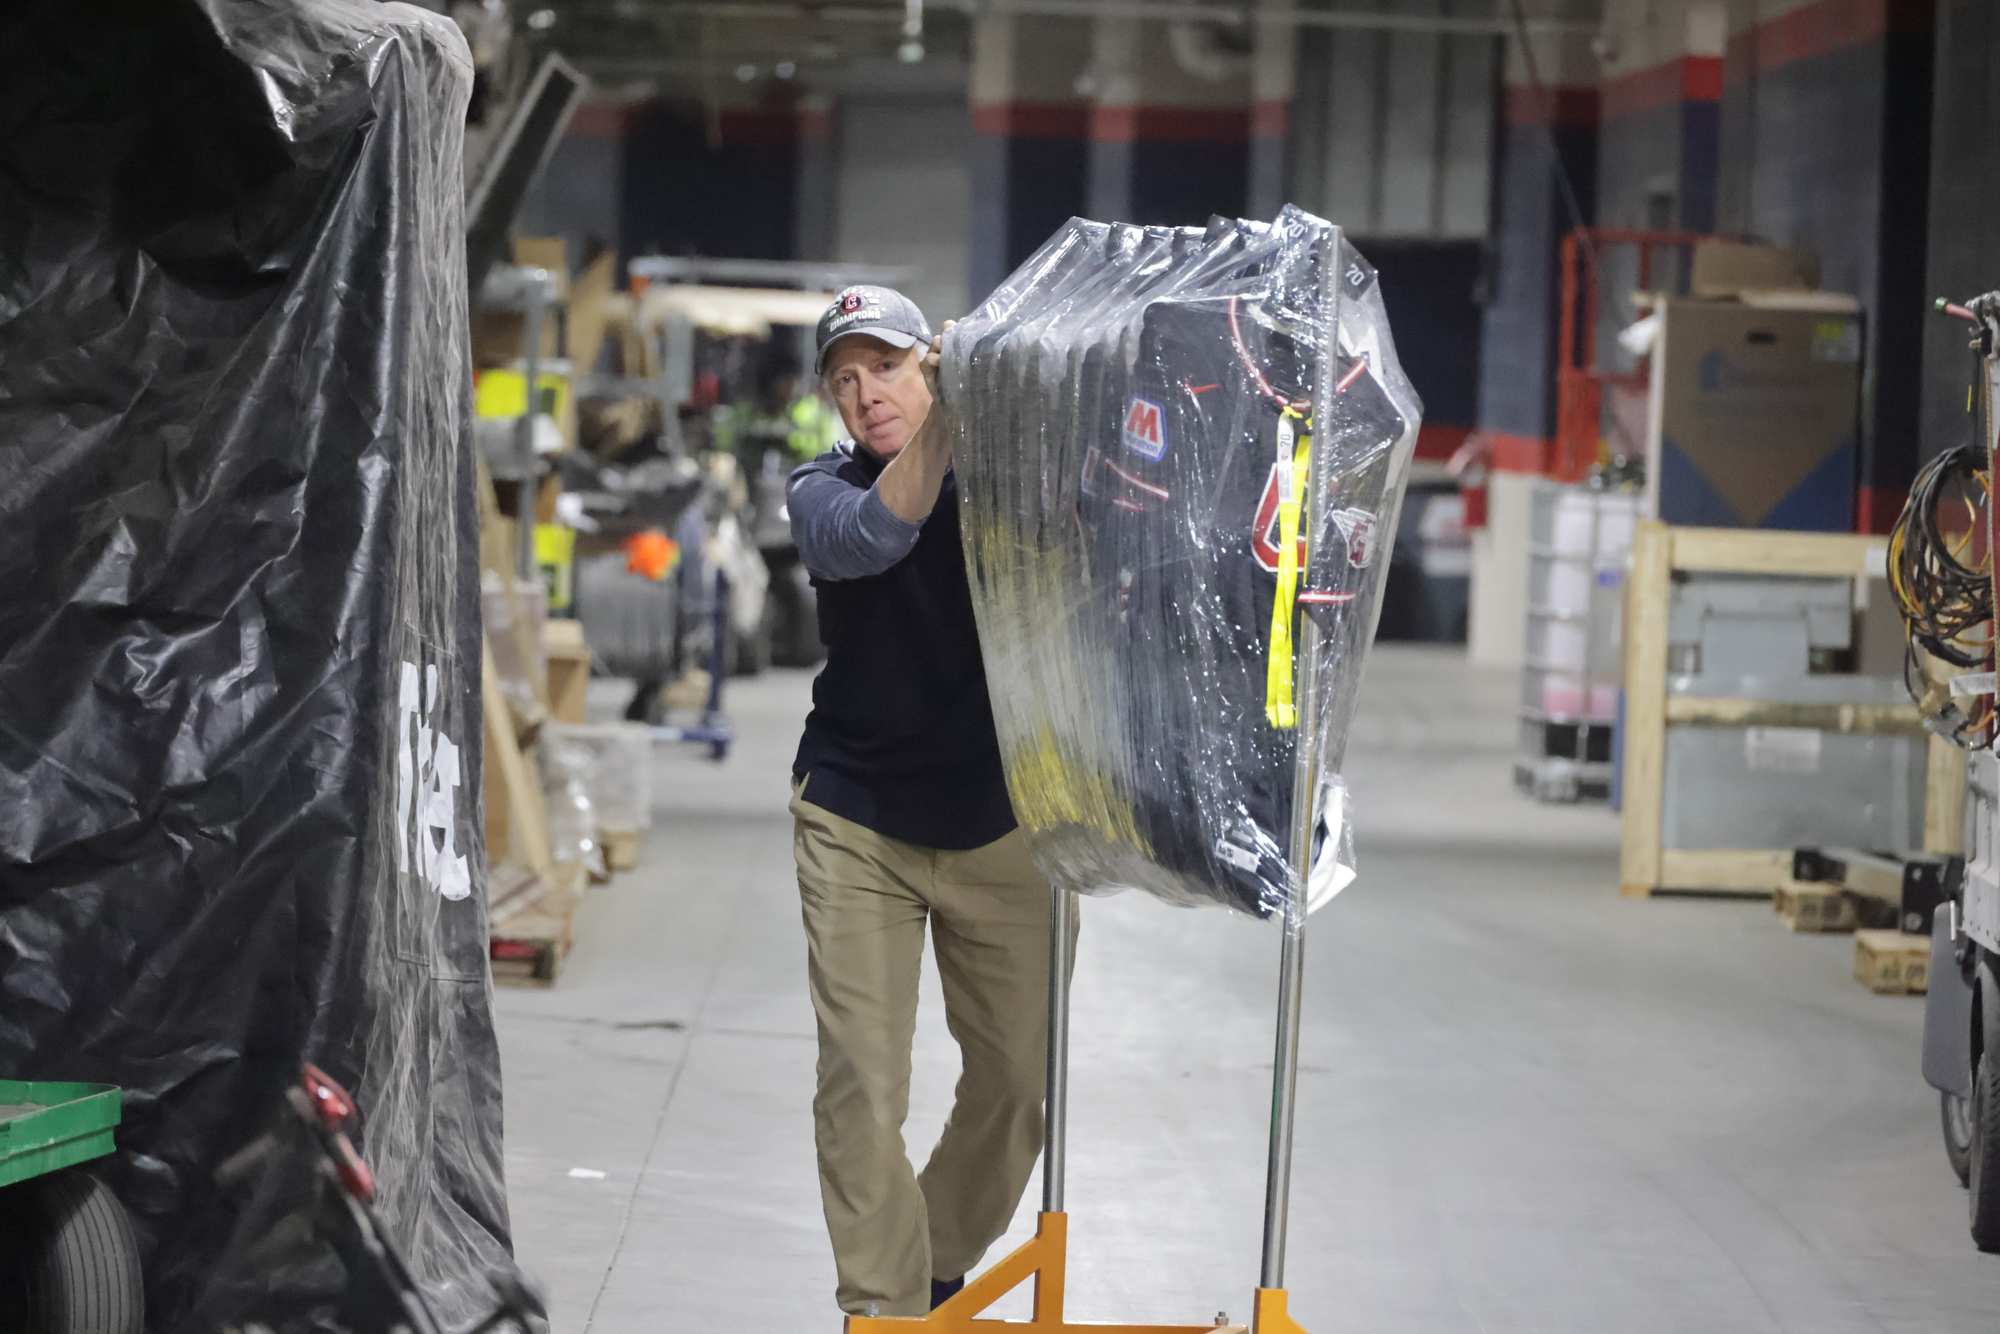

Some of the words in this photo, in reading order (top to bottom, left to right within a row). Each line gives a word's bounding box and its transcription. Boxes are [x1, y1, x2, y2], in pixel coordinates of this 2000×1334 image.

[1346, 263, 1365, 286] 70
[829, 310, 881, 333] CHAMPIONS
[1127, 402, 1158, 443] M
[1280, 434, 1291, 447] 70
